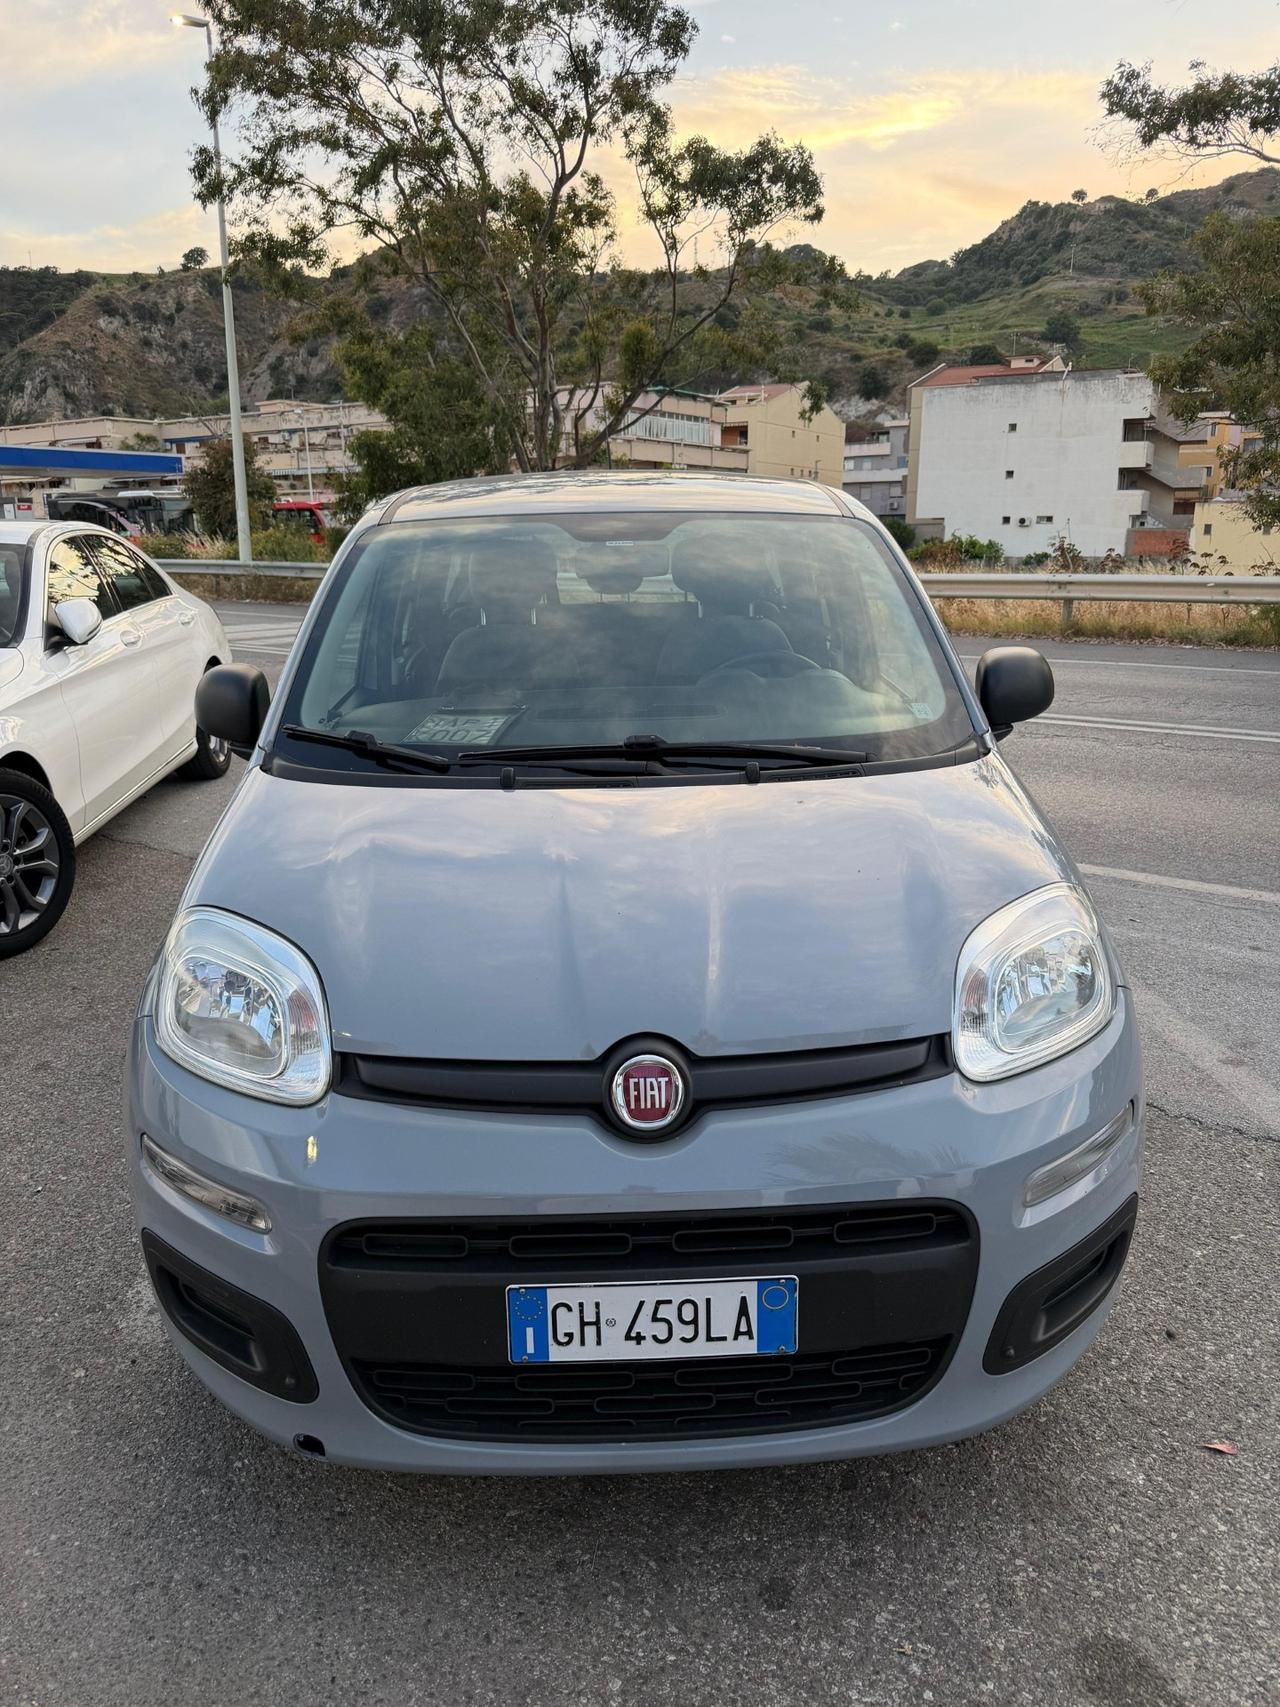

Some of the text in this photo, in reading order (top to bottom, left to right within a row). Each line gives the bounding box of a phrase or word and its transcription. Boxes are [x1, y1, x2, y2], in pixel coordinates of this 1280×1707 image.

[628, 1077, 669, 1109] FIAT
[551, 1295, 755, 1347] GH 459LA
